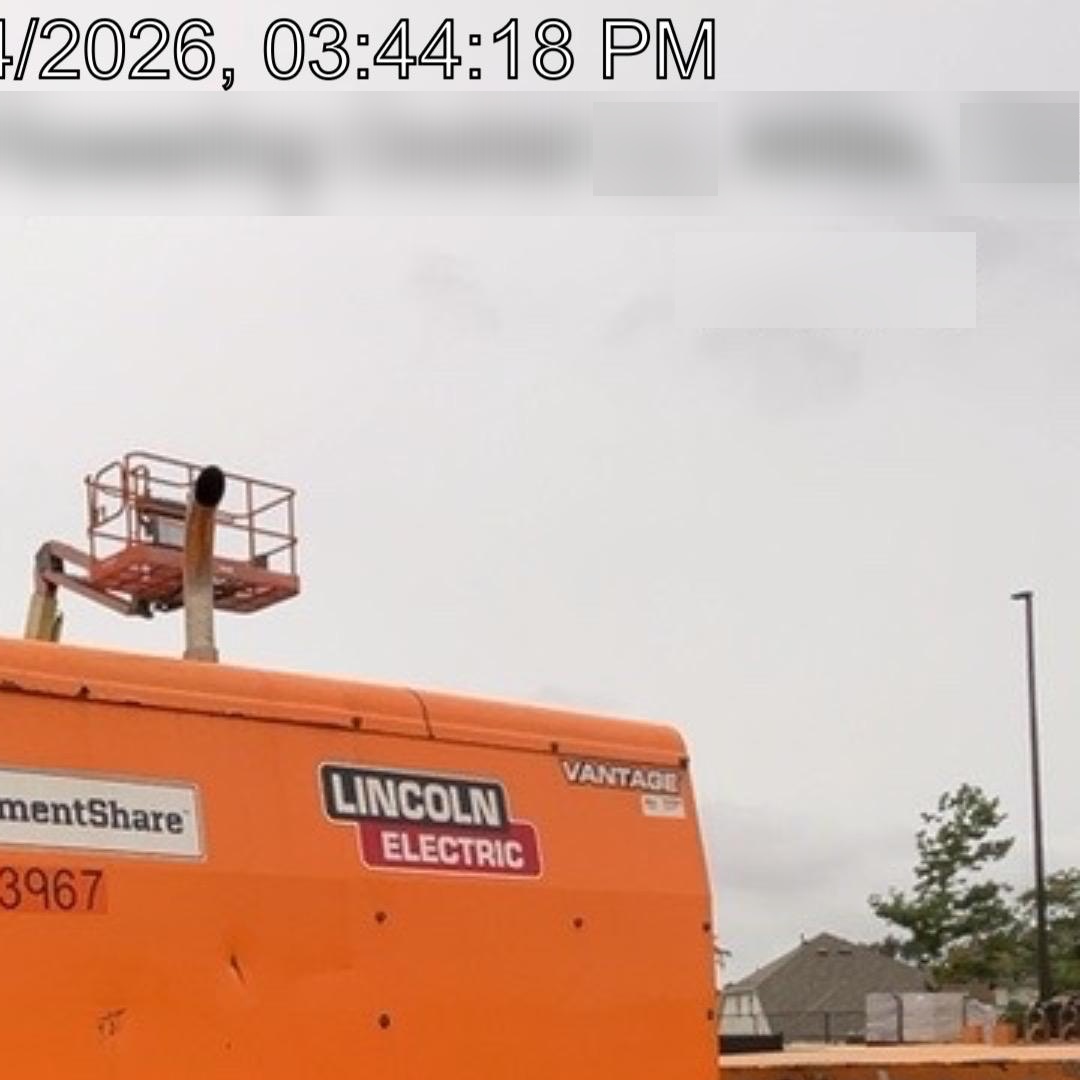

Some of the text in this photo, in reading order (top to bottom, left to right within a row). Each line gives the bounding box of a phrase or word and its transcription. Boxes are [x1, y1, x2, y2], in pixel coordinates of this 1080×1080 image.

[563, 761, 678, 792] VANTAGE
[331, 774, 502, 826] LINCOLN
[381, 832, 526, 869] ELECTRIC
